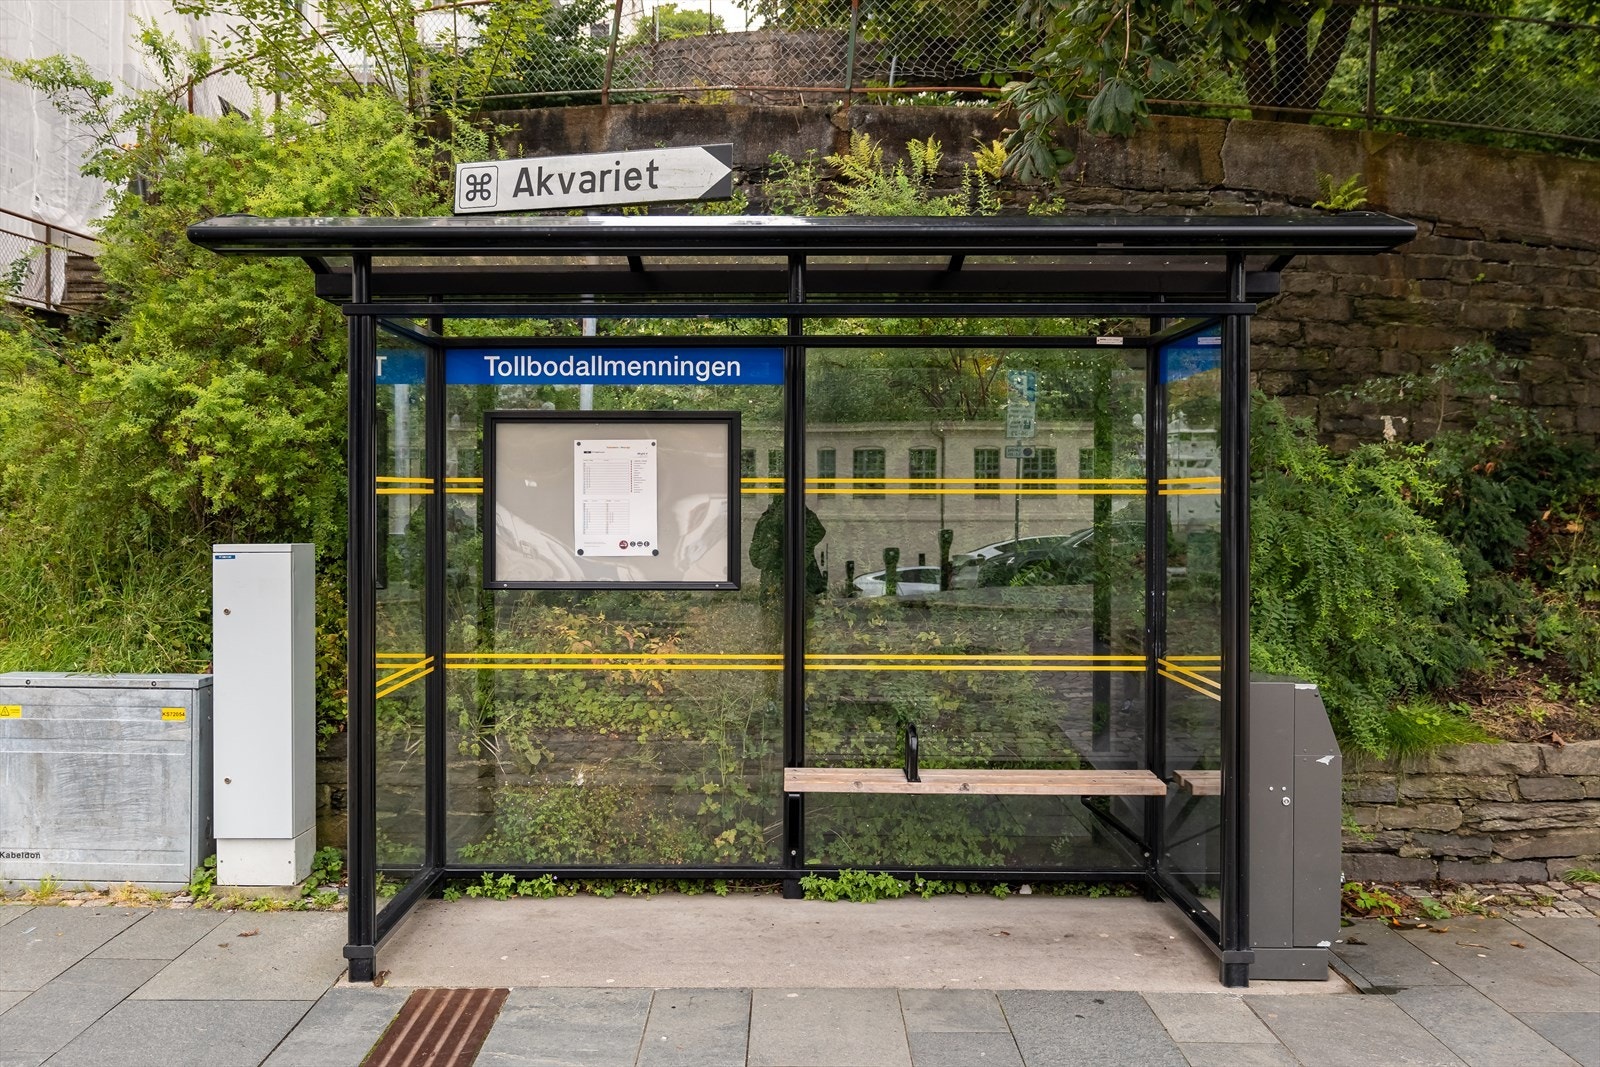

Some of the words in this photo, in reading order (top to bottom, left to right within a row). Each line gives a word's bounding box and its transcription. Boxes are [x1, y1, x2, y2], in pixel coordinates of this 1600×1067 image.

[512, 158, 659, 198] Akvariet
[483, 355, 741, 382] Tollbodallmenningen
[0, 851, 41, 859] Kabeldon
